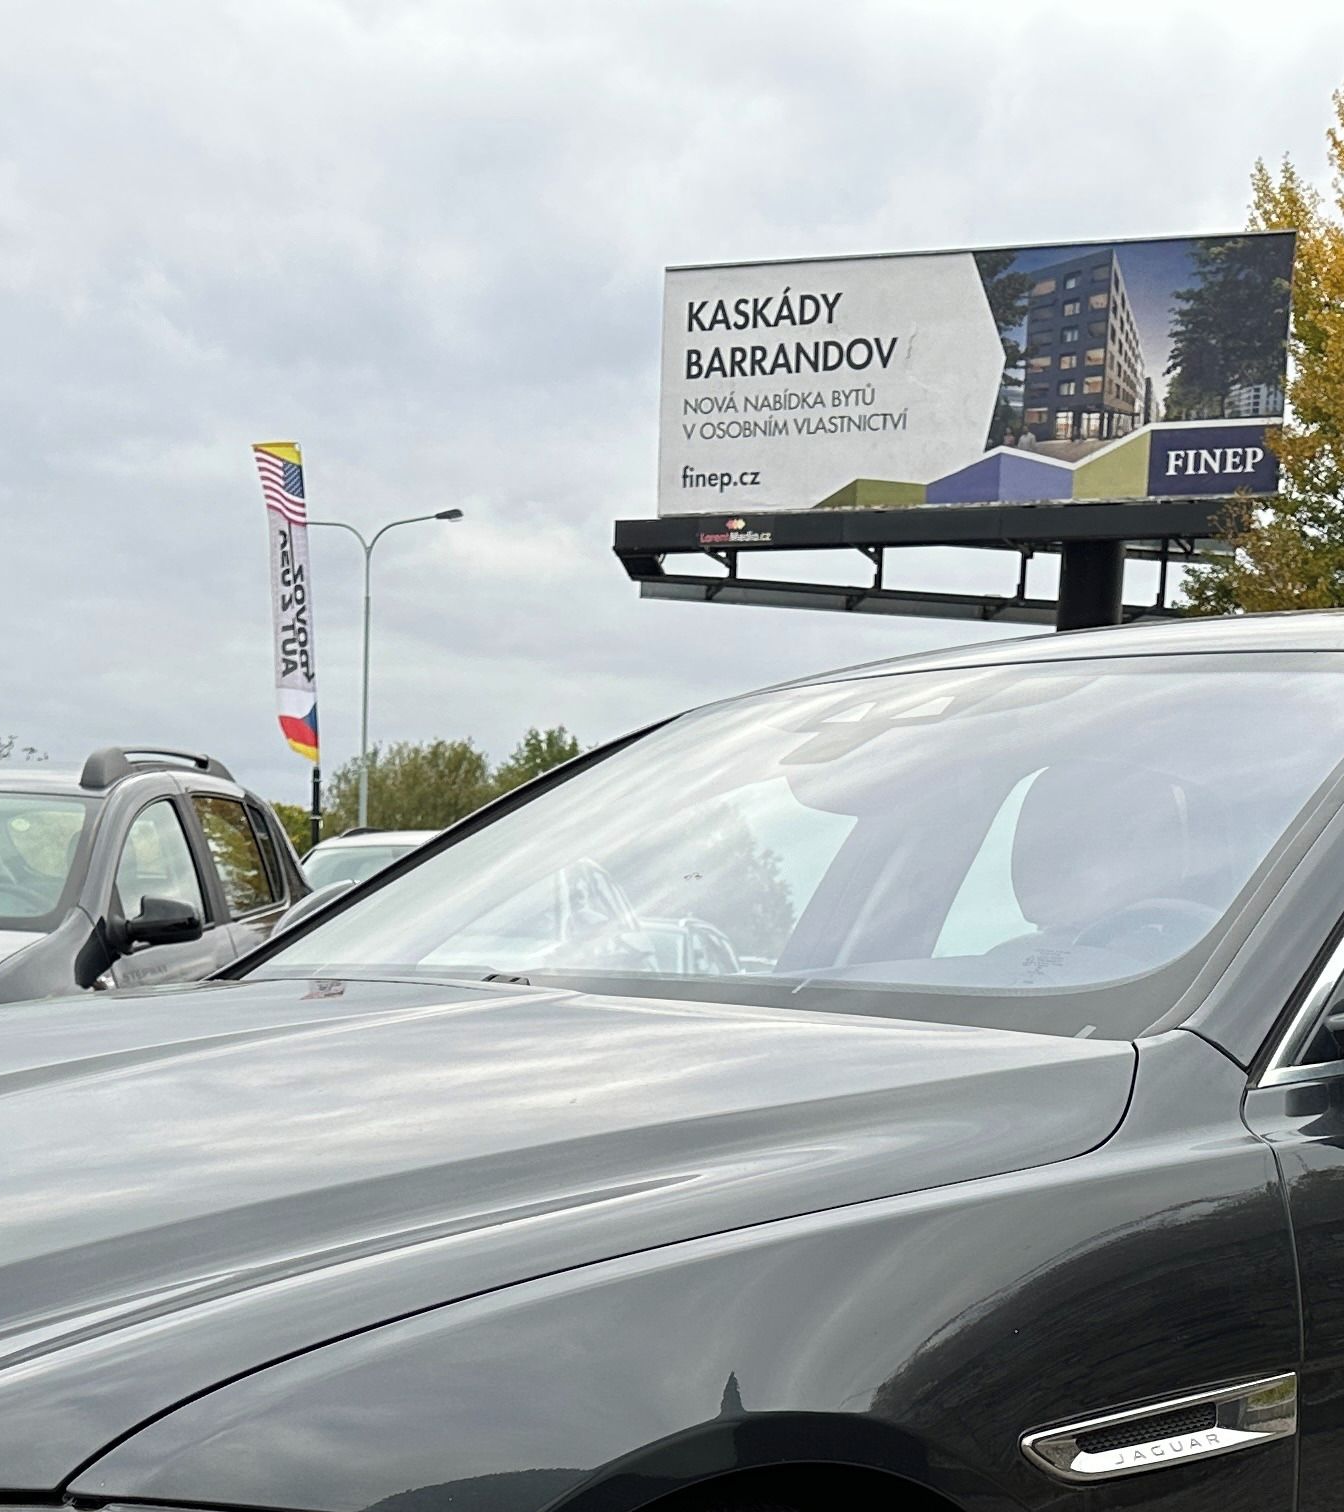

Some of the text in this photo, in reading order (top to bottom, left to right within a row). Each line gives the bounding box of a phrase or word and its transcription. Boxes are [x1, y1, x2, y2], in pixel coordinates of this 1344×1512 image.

[687, 286, 843, 332] KASKÁDY
[686, 337, 898, 379] BARRANDOV
[683, 383, 875, 415] NOVÁ NABÍDKA BYTŮ
[683, 408, 908, 440] V OSOBNÍM VLASTNICTVÍ
[1165, 446, 1265, 477] FINEP
[681, 465, 761, 493] finep.cz
[1114, 1433, 1221, 1465] JAGUAR
